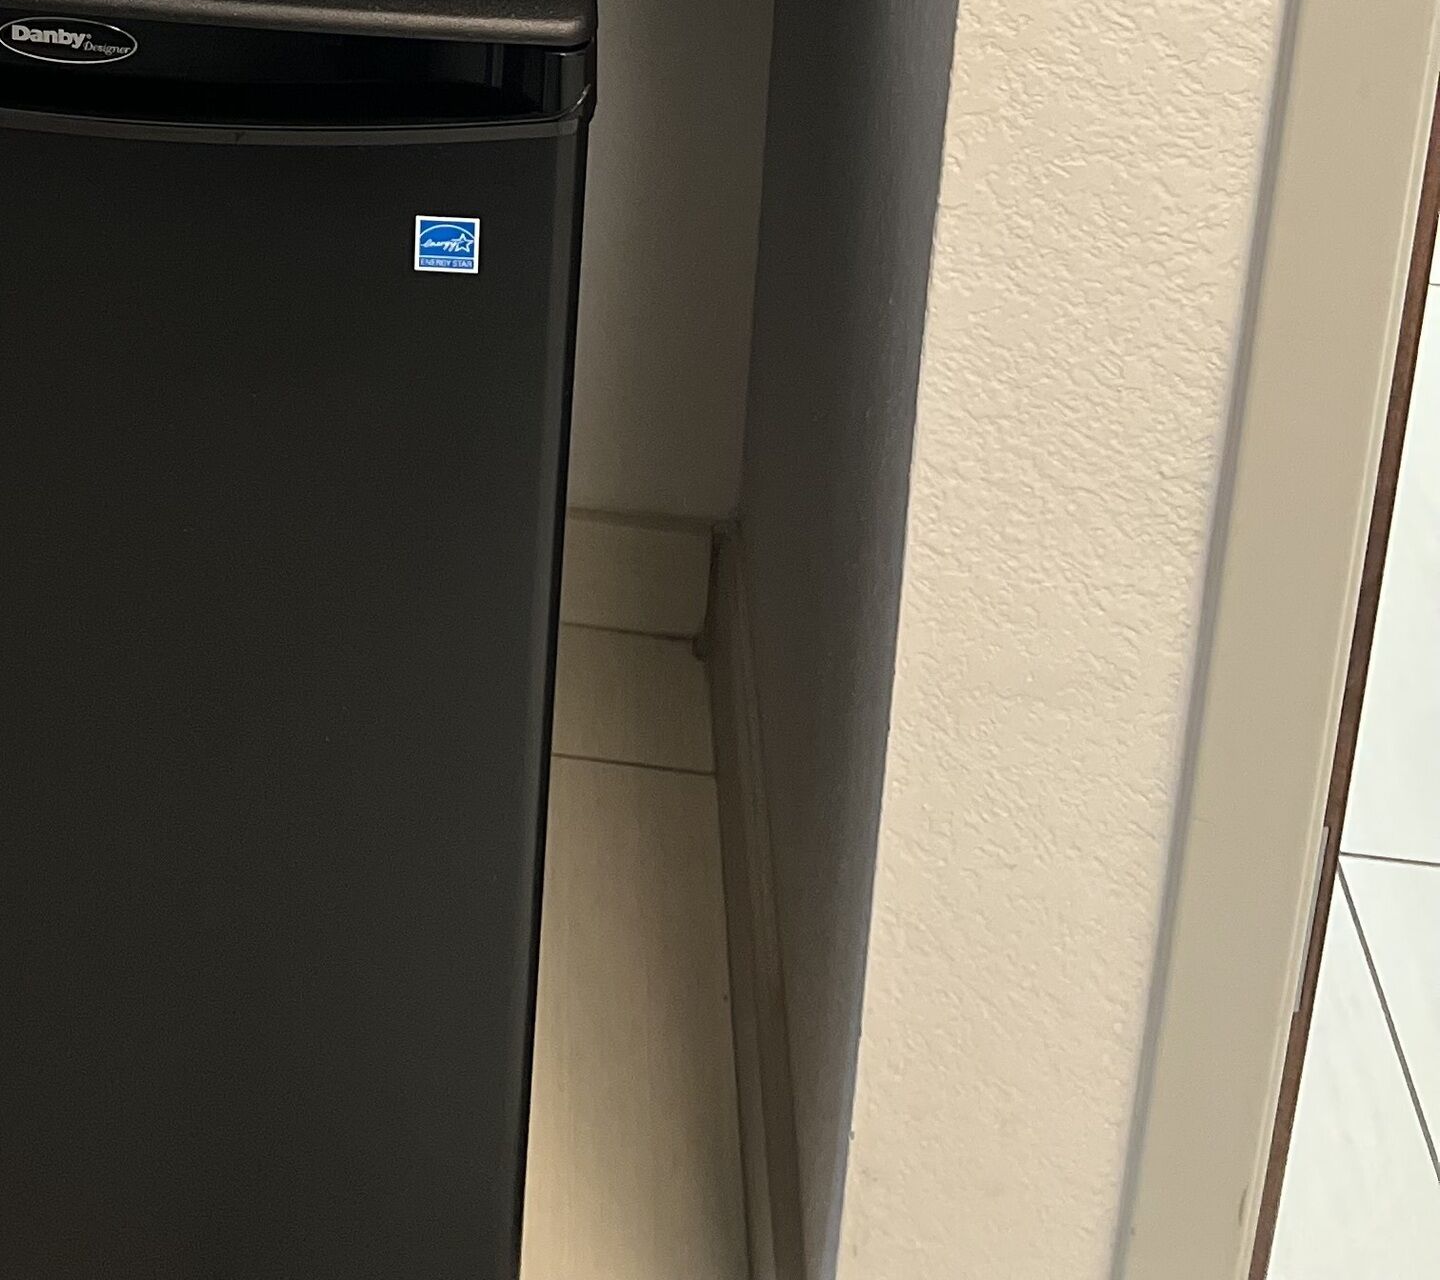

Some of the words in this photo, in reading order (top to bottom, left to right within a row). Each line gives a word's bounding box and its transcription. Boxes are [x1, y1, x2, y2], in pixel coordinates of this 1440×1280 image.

[11, 24, 85, 49] Danby
[83, 41, 131, 55] Designer
[452, 260, 472, 268] STAR
